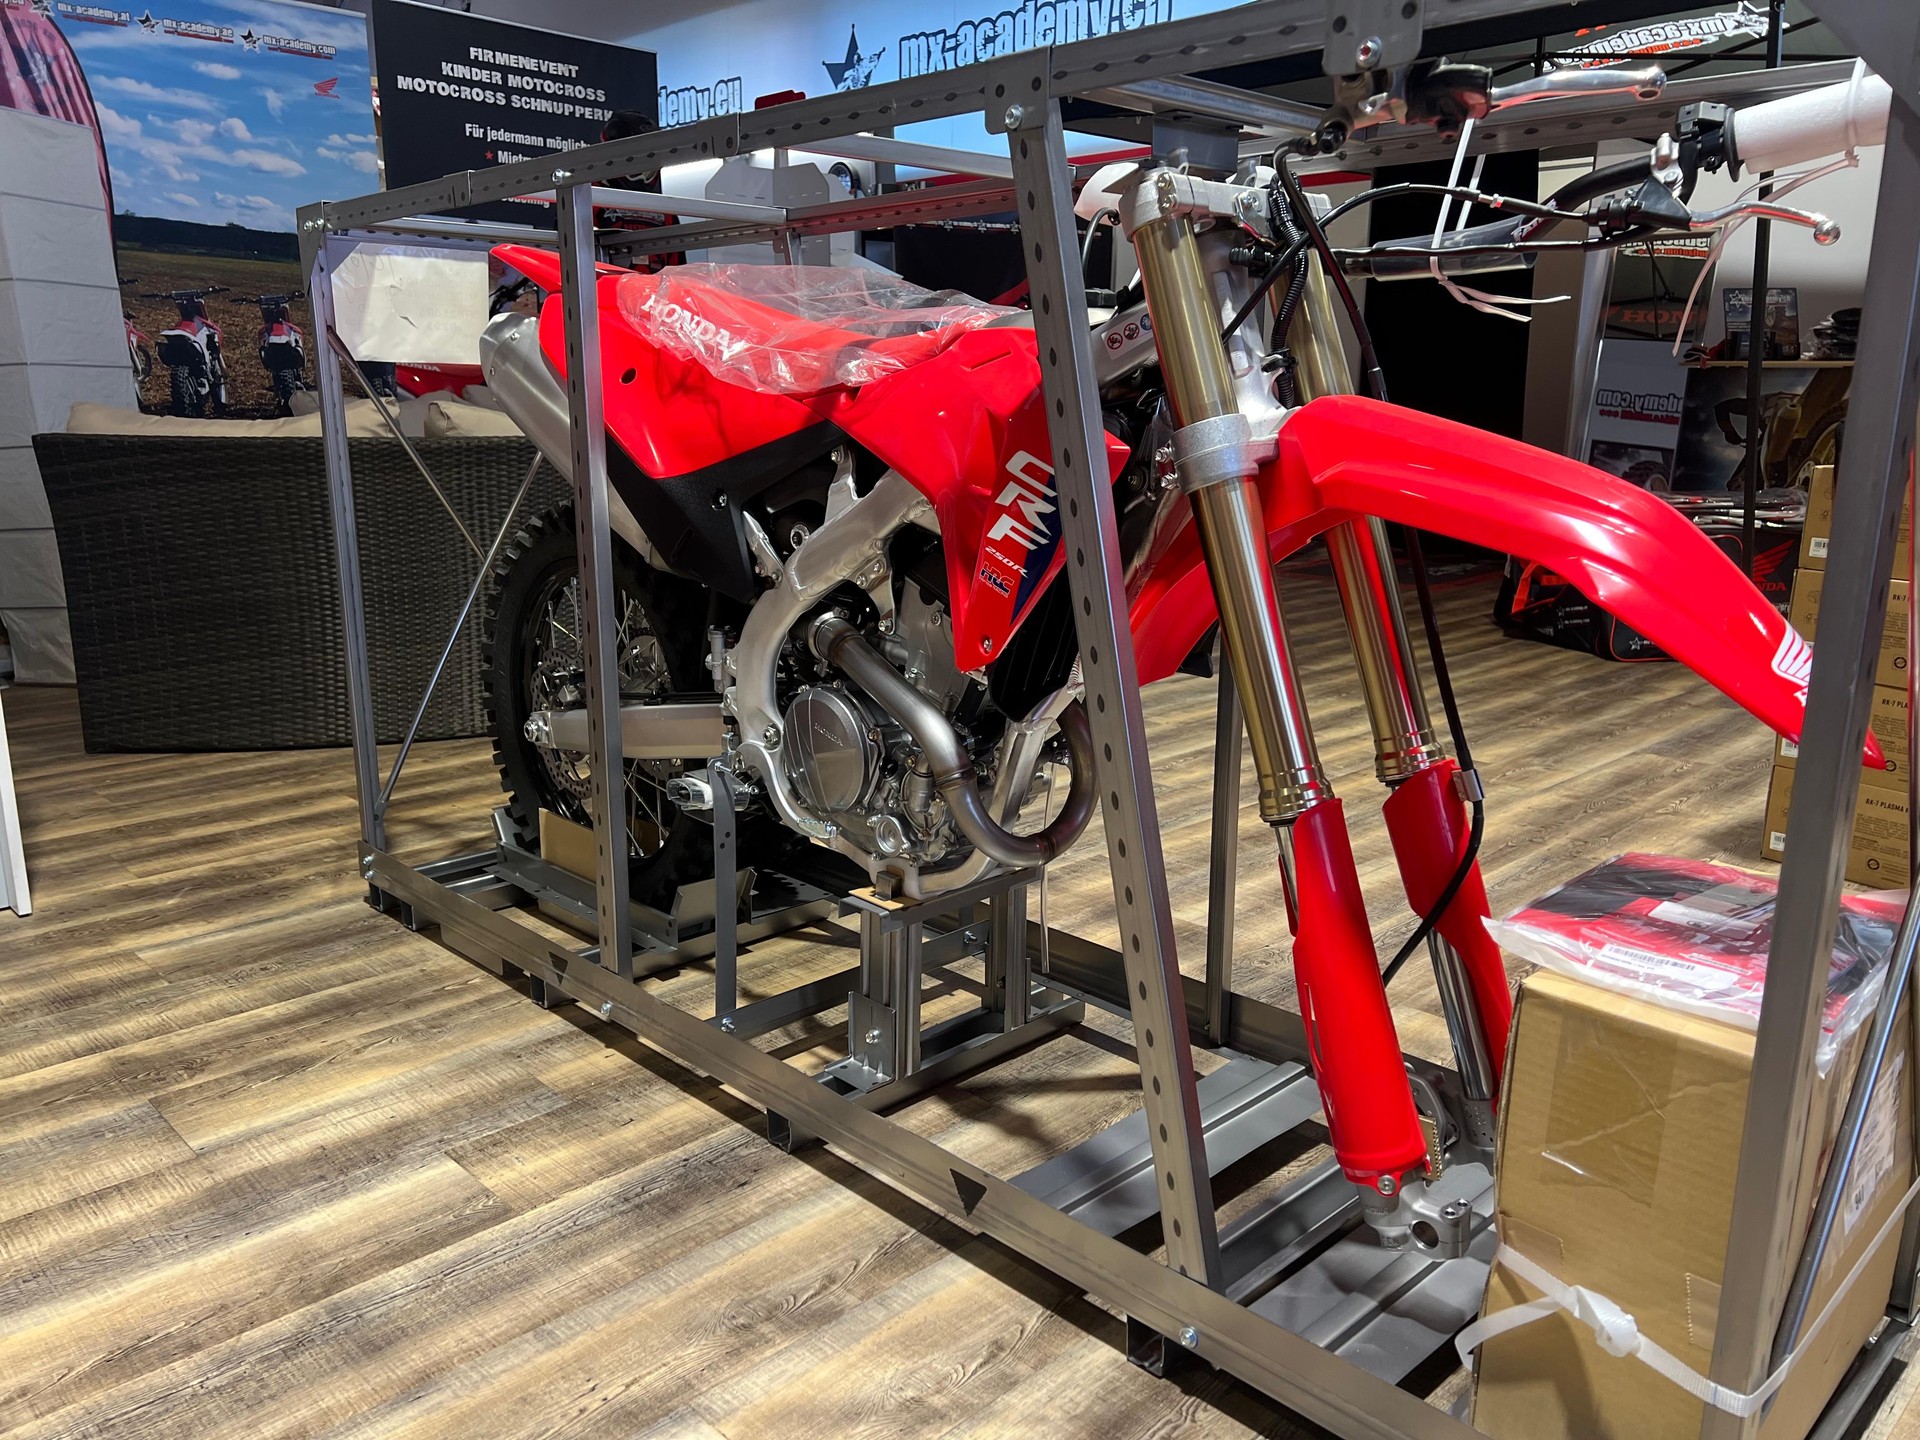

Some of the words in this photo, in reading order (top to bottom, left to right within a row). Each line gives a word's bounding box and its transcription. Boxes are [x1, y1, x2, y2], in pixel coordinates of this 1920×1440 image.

[57, 2, 131, 21] mx-academy.at
[263, 34, 337, 55] mx-academy.com
[469, 46, 579, 78] FIRMENEVENT
[396, 75, 507, 106] MOTOCROSS
[441, 61, 502, 85] KINDER
[507, 73, 607, 103] MOTOCROSS
[465, 123, 485, 139] Für
[486, 126, 545, 148] jedermann
[984, 545, 1029, 578] 250R
[1881, 698, 1896, 707] RK-7
[1865, 798, 1879, 807] RK-7
[1879, 800, 1904, 813] PLASMA
